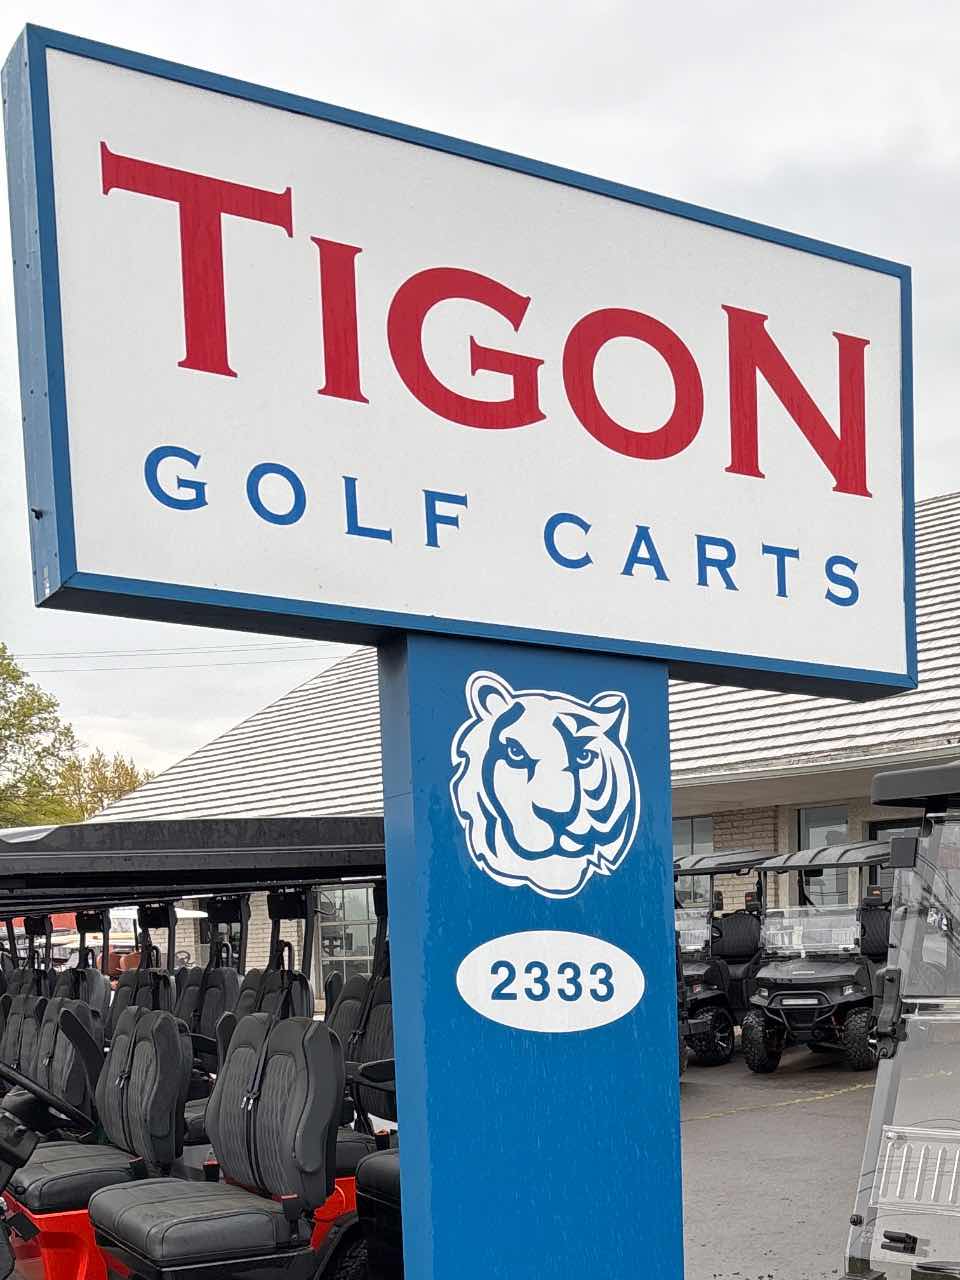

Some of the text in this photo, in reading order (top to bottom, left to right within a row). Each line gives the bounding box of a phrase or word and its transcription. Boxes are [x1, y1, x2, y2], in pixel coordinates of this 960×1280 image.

[100, 140, 872, 498] TIGON
[144, 444, 861, 607] GOLF CARTS
[490, 960, 615, 1002] 2333
